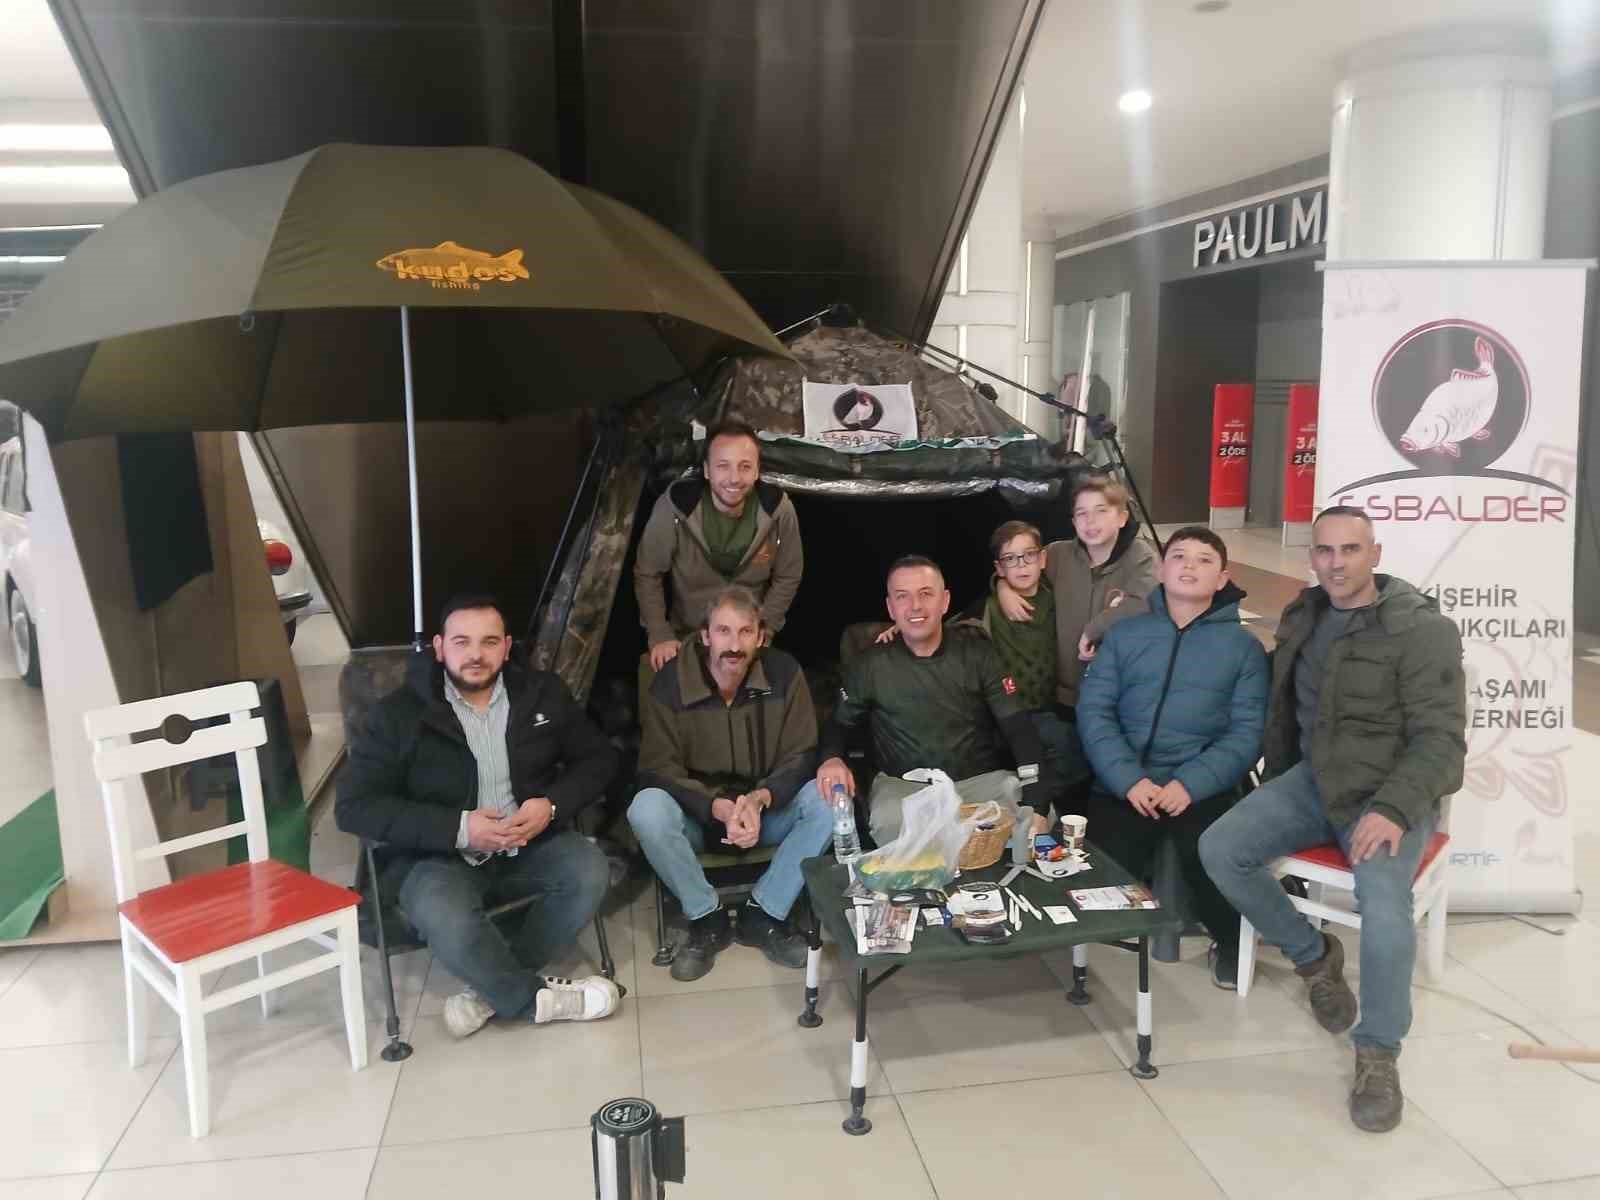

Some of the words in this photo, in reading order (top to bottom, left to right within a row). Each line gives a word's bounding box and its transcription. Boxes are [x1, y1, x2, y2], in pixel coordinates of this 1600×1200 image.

[1193, 191, 1328, 269] PAULM
[395, 258, 517, 281] kudos
[431, 280, 480, 292] fishing
[1221, 431, 1229, 443] 3
[1231, 431, 1246, 443] AL
[1296, 437, 1305, 449] 3
[1219, 448, 1226, 456] 2
[1302, 452, 1317, 464] ÖD
[1417, 584, 1518, 611] İŞEHİR
[1460, 618, 1566, 642] IKÇILARI
[1470, 678, 1546, 701] AŞAMI
[1471, 706, 1564, 729] ERNEĞİ
[1449, 850, 1502, 866] RTİF
